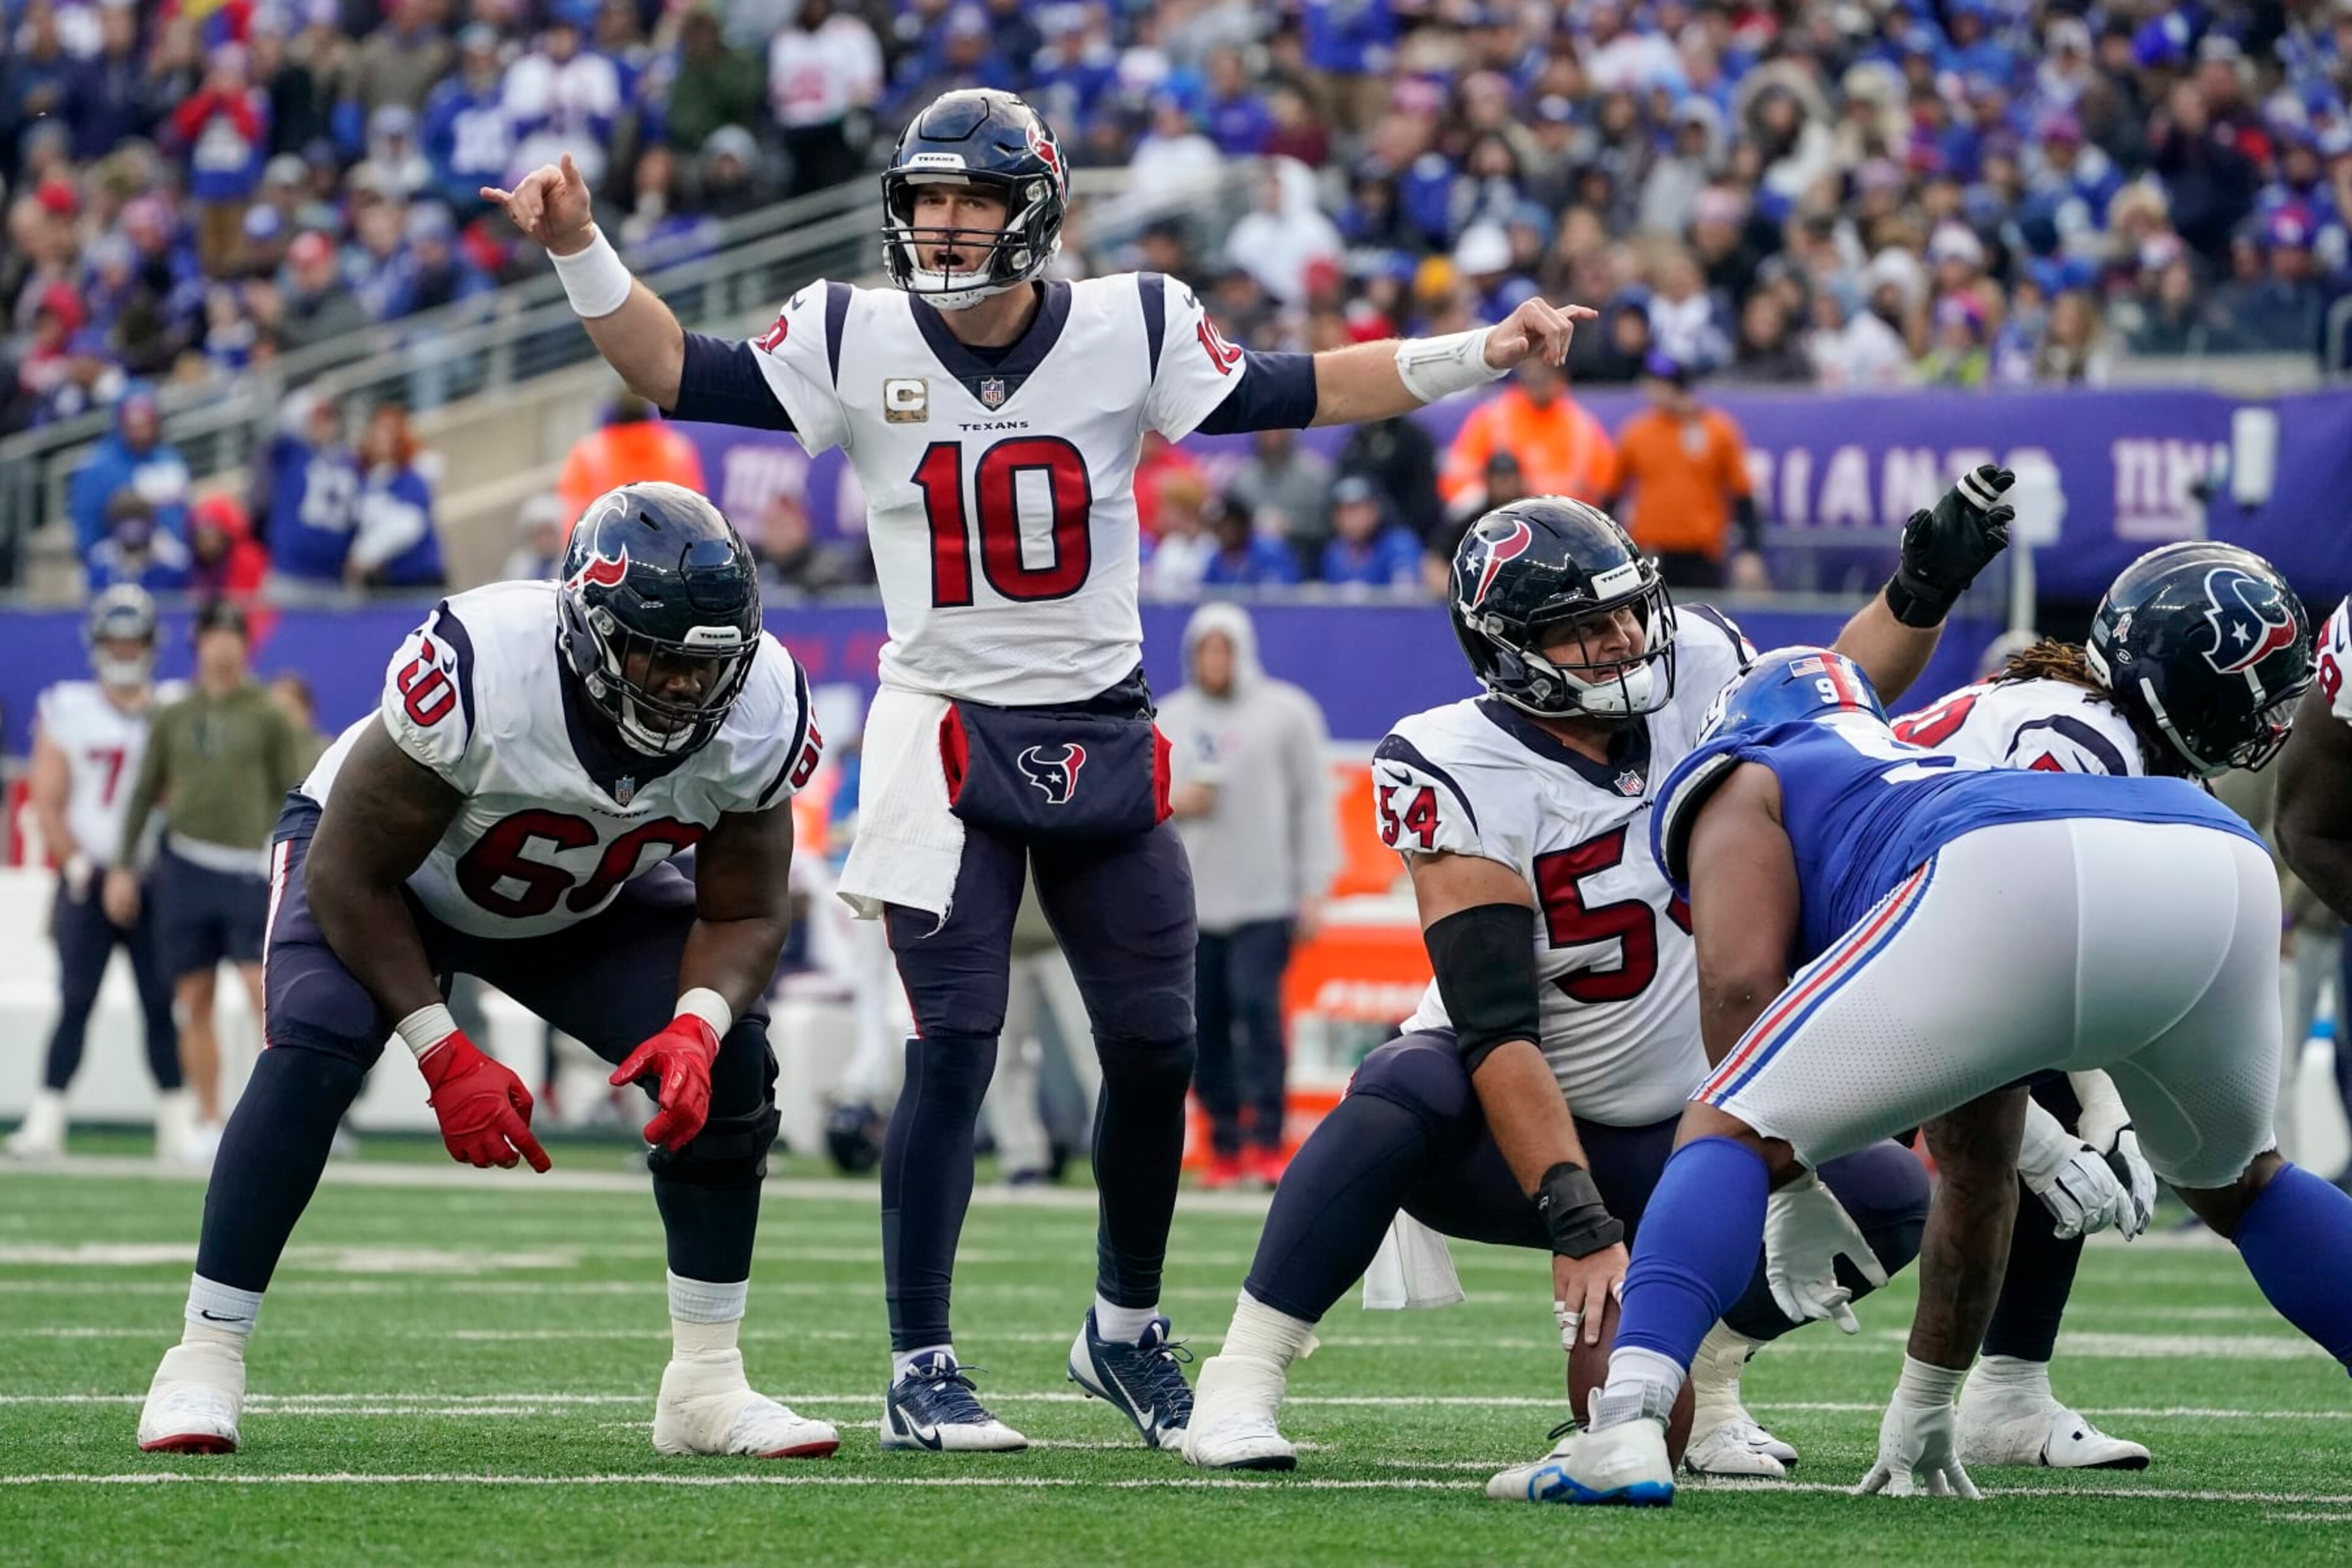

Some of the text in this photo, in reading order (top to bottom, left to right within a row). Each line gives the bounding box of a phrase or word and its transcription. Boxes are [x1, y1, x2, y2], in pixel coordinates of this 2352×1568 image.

[886, 380, 925, 411] C
[958, 421, 1030, 431] TEXANS
[910, 435, 1093, 608] 10
[398, 636, 456, 727] 60
[85, 746, 125, 807] 7
[1379, 785, 1441, 850] 54
[1532, 822, 1694, 1004] 5
